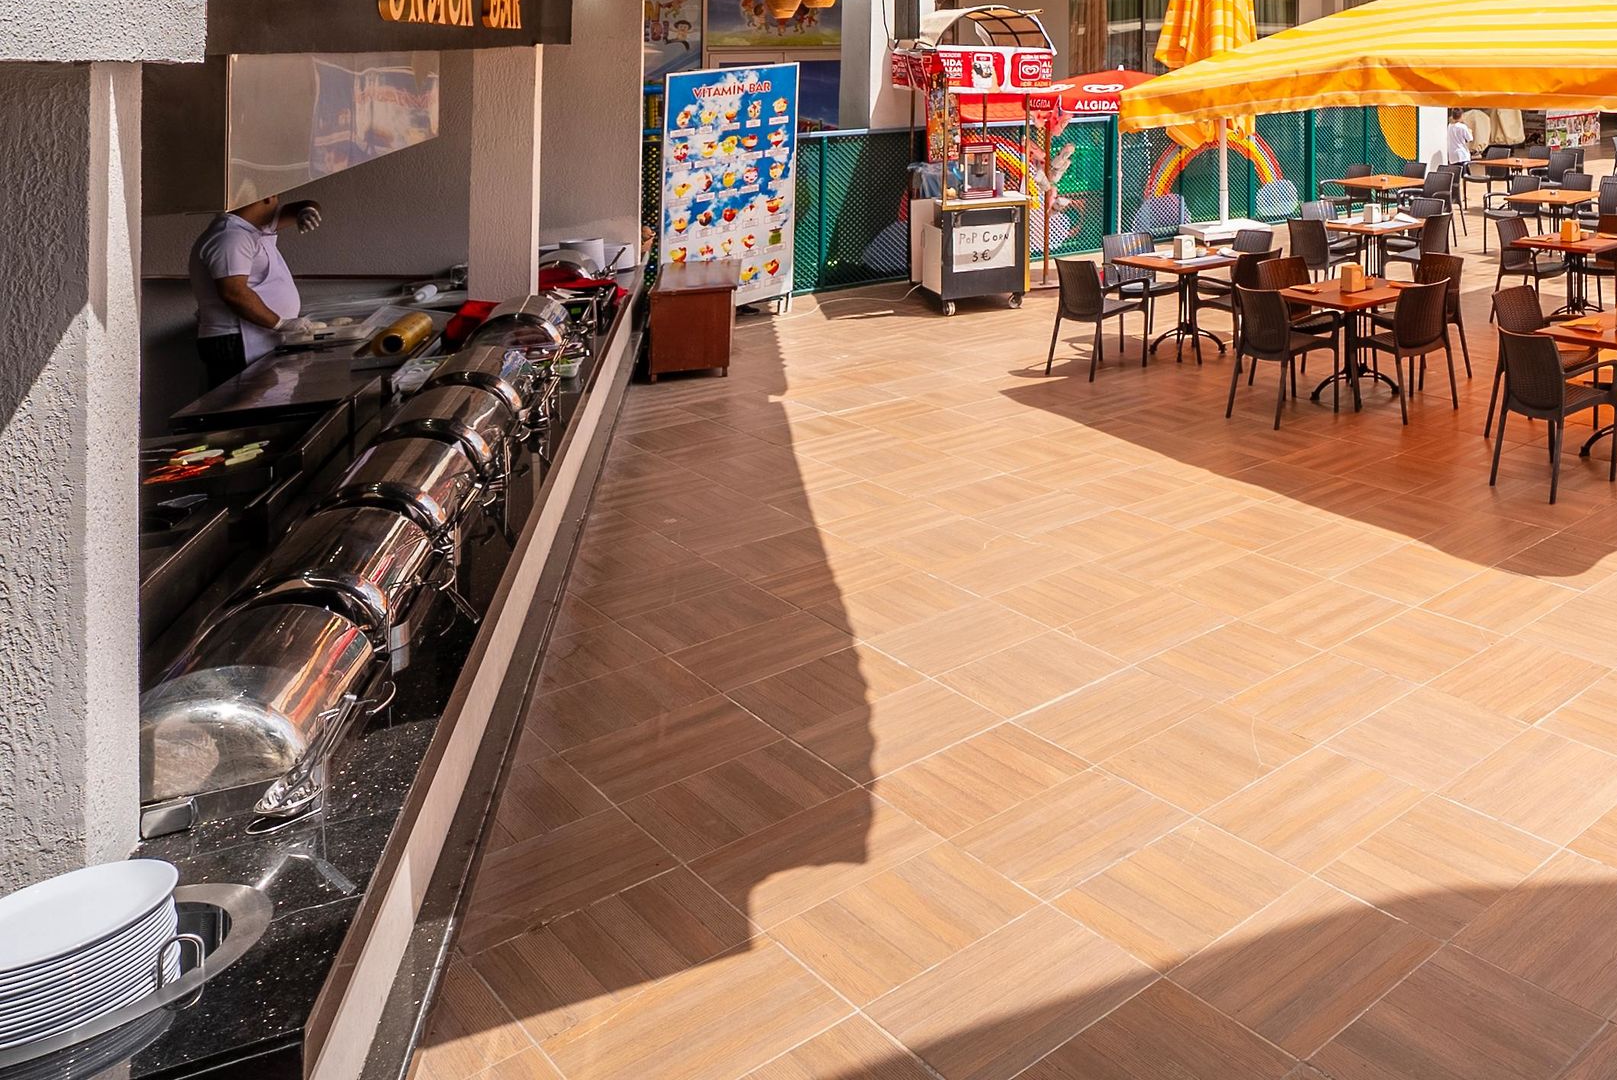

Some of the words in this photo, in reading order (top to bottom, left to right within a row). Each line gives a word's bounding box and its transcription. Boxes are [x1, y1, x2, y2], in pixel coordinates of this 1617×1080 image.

[748, 81, 771, 93] BAR
[1075, 100, 1118, 110] ALGIDA
[971, 250, 979, 263] 3
[980, 248, 992, 261] €
